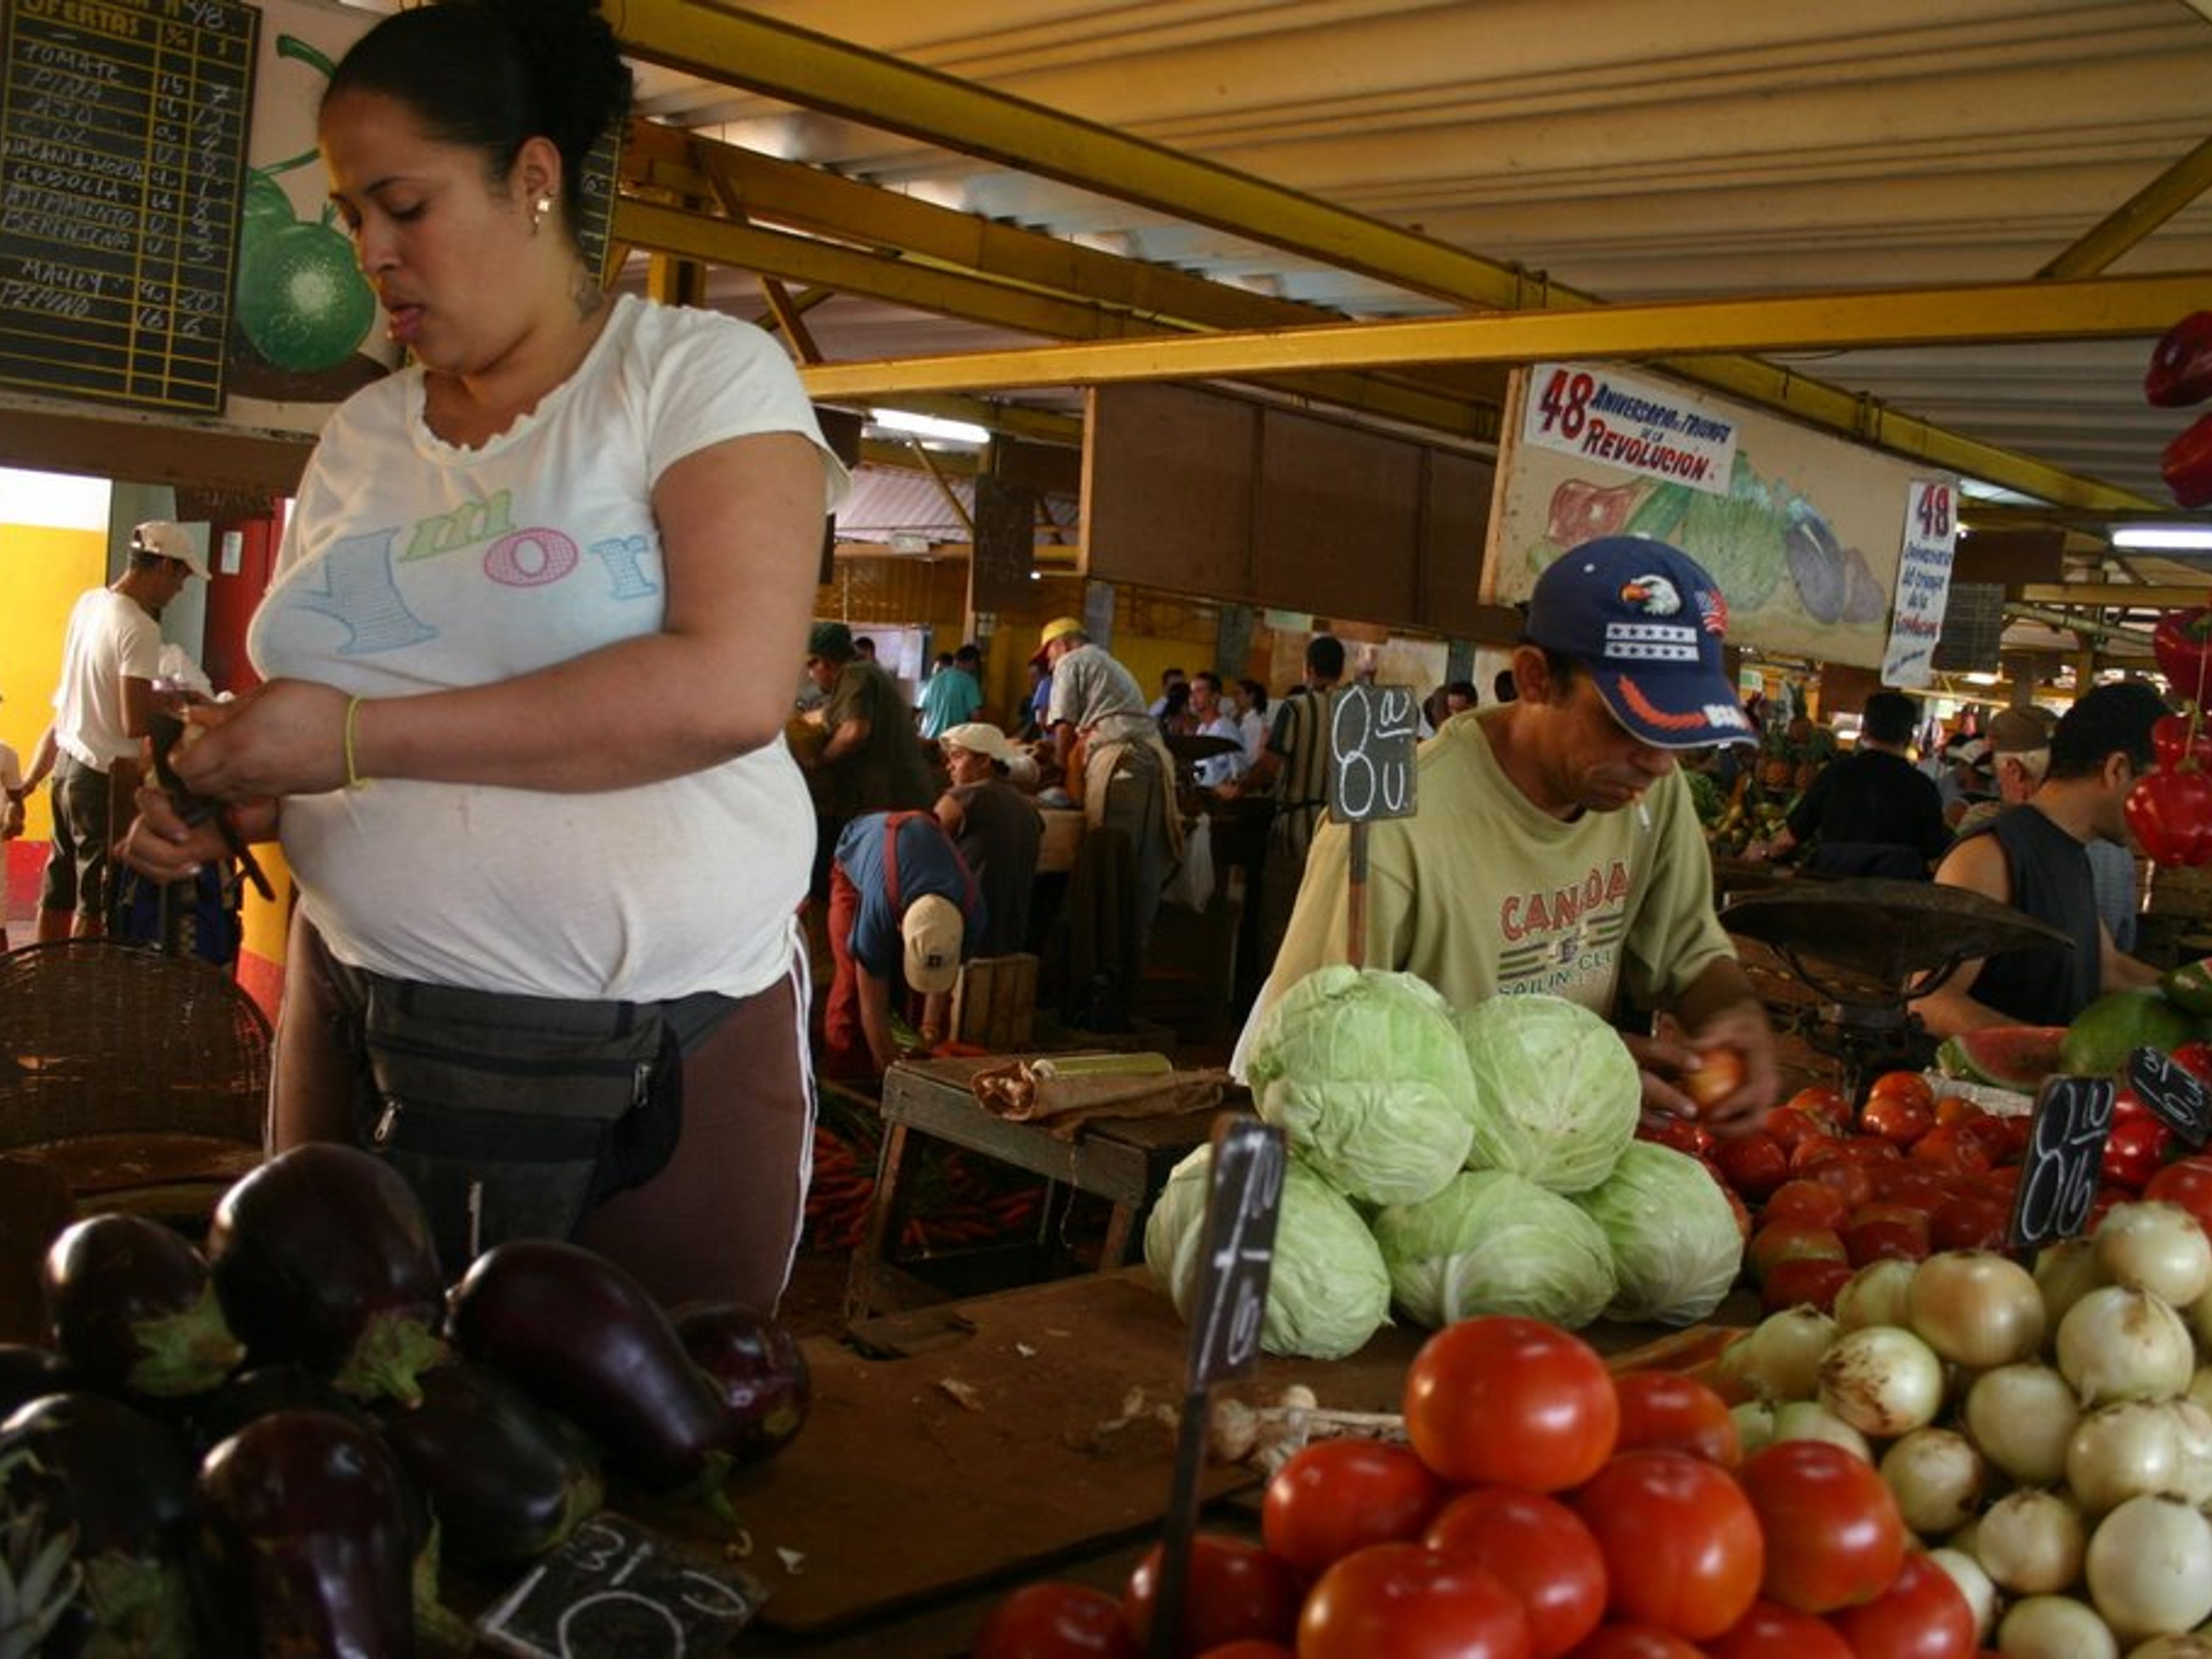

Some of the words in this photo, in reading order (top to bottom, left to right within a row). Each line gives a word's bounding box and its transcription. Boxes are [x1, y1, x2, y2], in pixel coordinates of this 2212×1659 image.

[24, 0, 141, 36] OFERTAS
[1539, 369, 1595, 441] 48
[1917, 483, 1950, 538] 48
[1331, 685, 1376, 817] 8
[1501, 861, 1629, 942] CANDA
